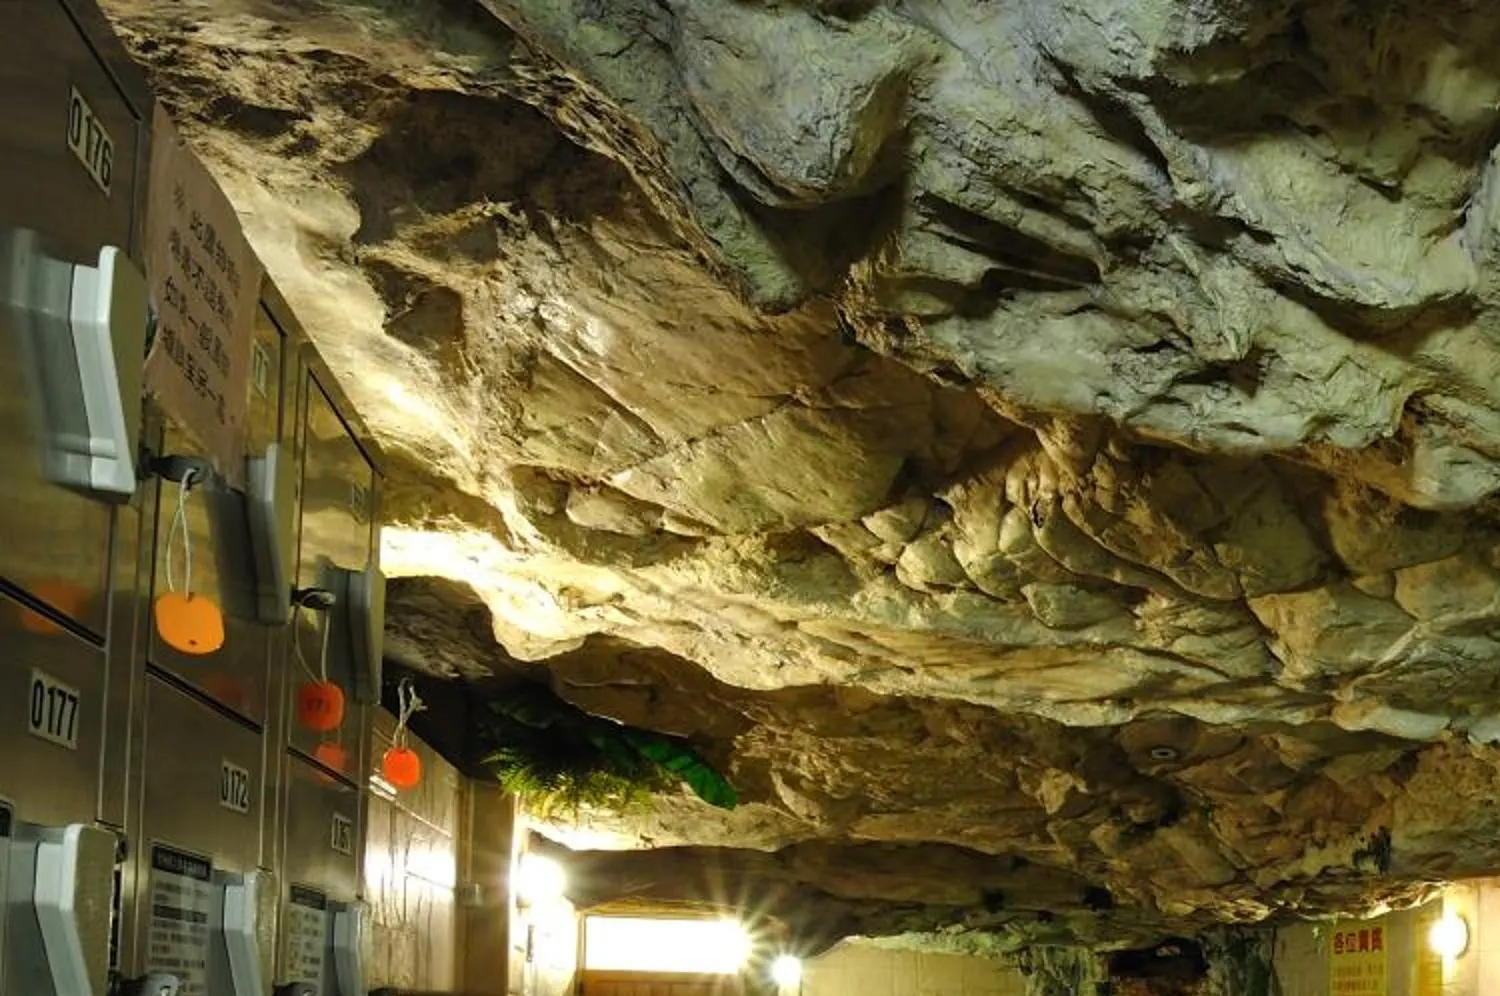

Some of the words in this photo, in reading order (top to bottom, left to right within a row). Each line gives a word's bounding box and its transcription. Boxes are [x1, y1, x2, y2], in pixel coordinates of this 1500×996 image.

[72, 98, 111, 187] 0176
[32, 679, 77, 741] 0177
[222, 766, 248, 808] 0172
